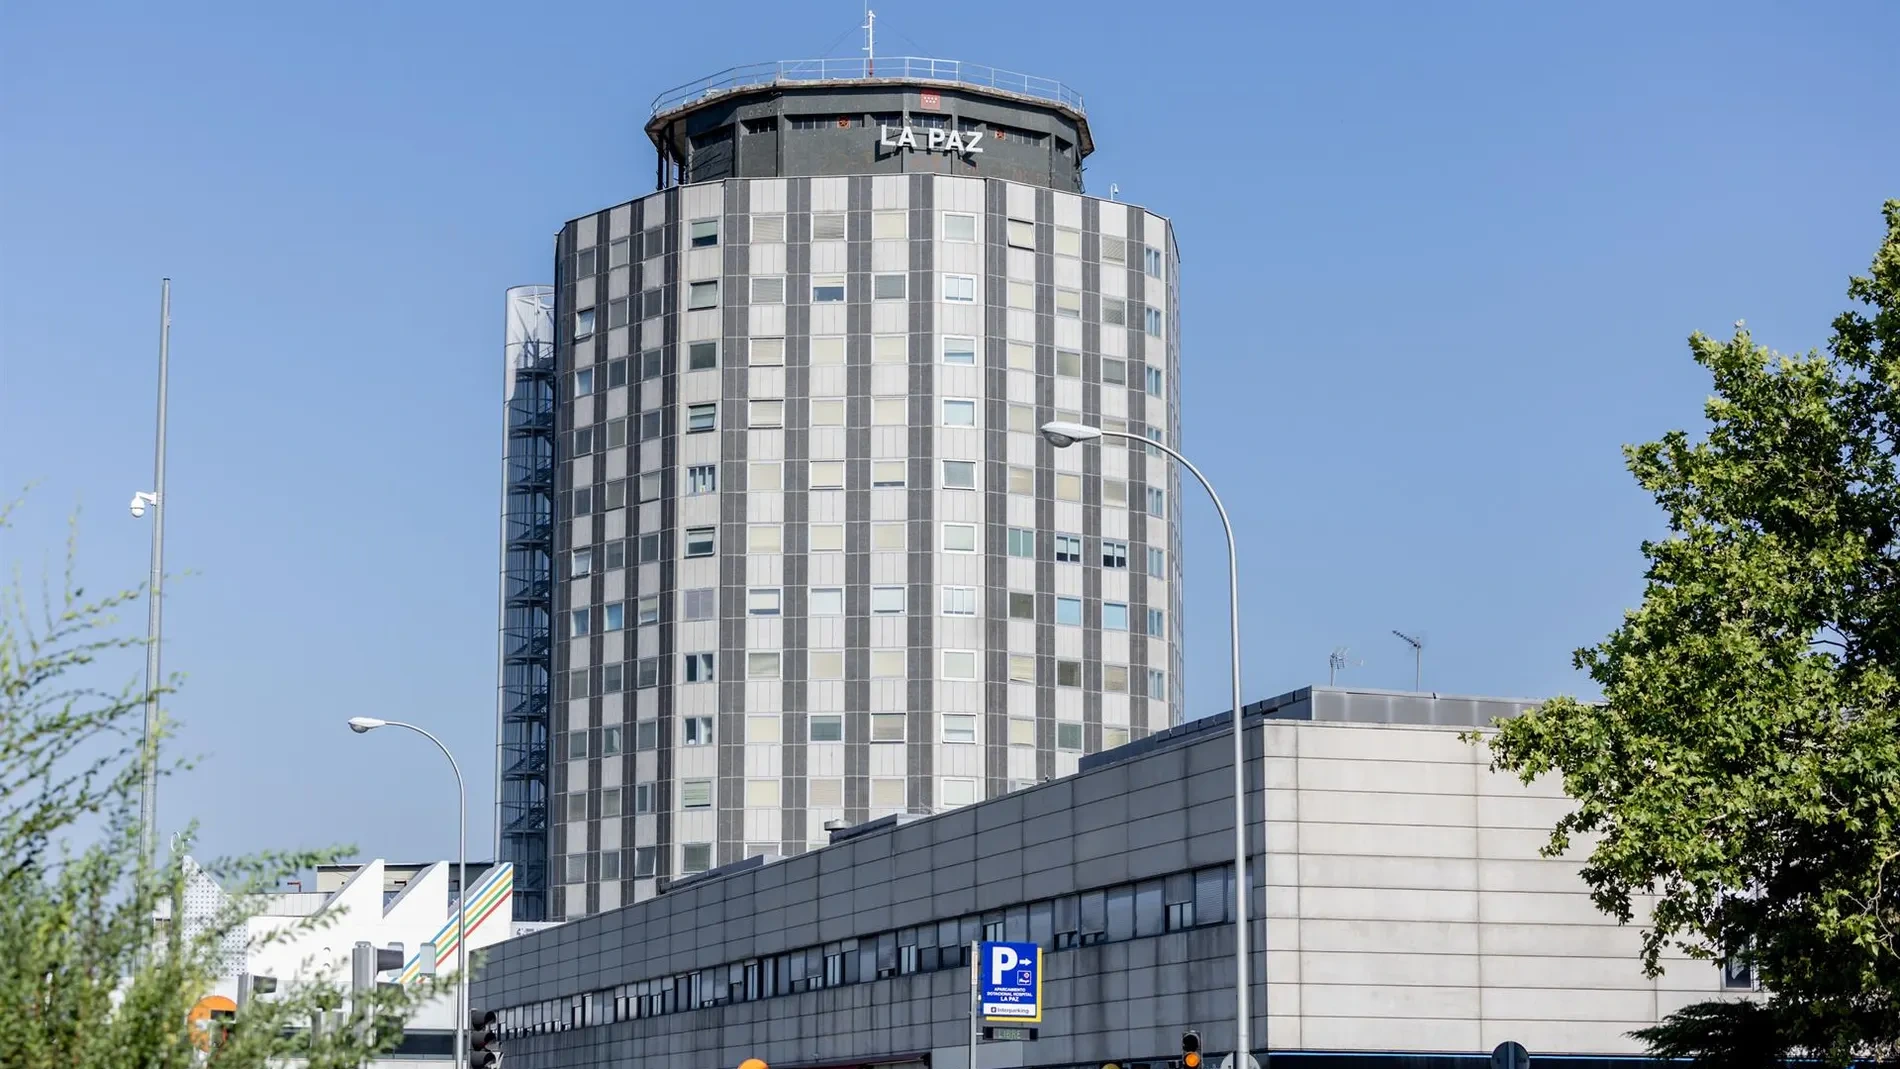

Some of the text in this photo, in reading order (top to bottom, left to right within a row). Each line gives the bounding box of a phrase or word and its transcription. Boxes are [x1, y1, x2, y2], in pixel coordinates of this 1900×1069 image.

[881, 124, 983, 153] LA PAZ
[992, 946, 1018, 985] P
